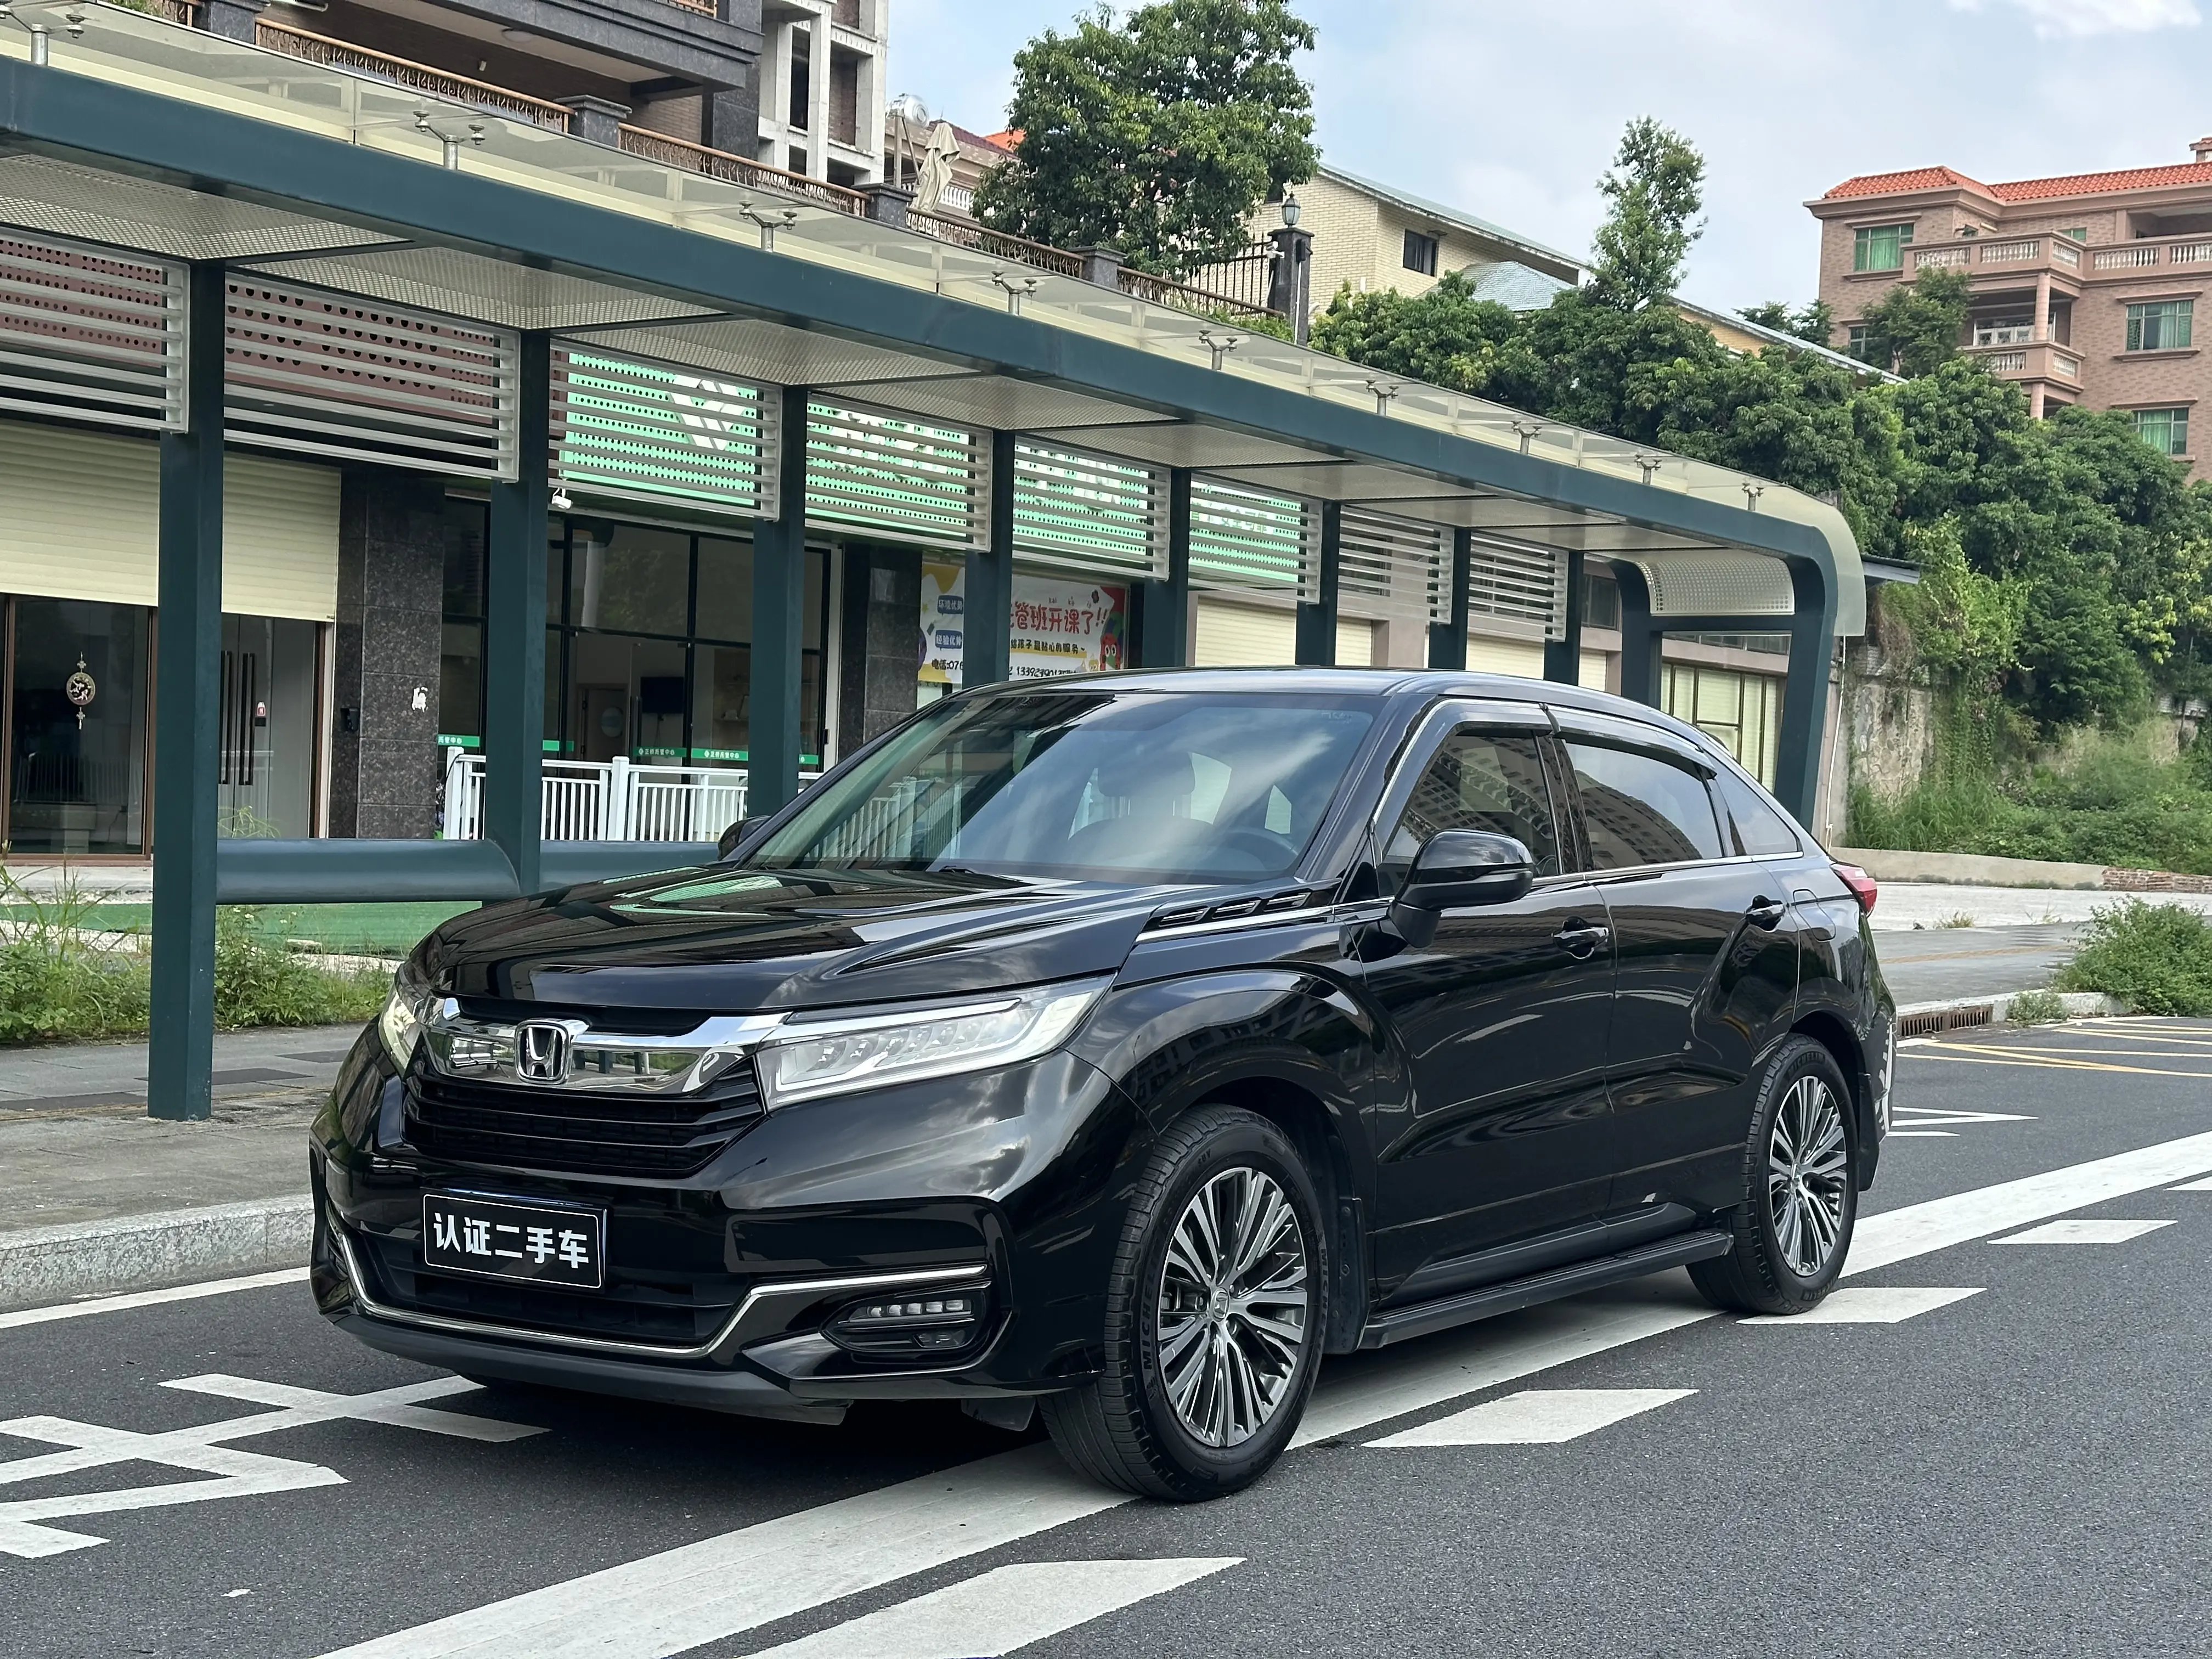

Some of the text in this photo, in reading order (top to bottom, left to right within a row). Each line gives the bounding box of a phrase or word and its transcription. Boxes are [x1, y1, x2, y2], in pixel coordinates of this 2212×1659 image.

[1010, 601, 1108, 635] 管班开课了!!
[433, 1212, 589, 1269] 认证二手车
